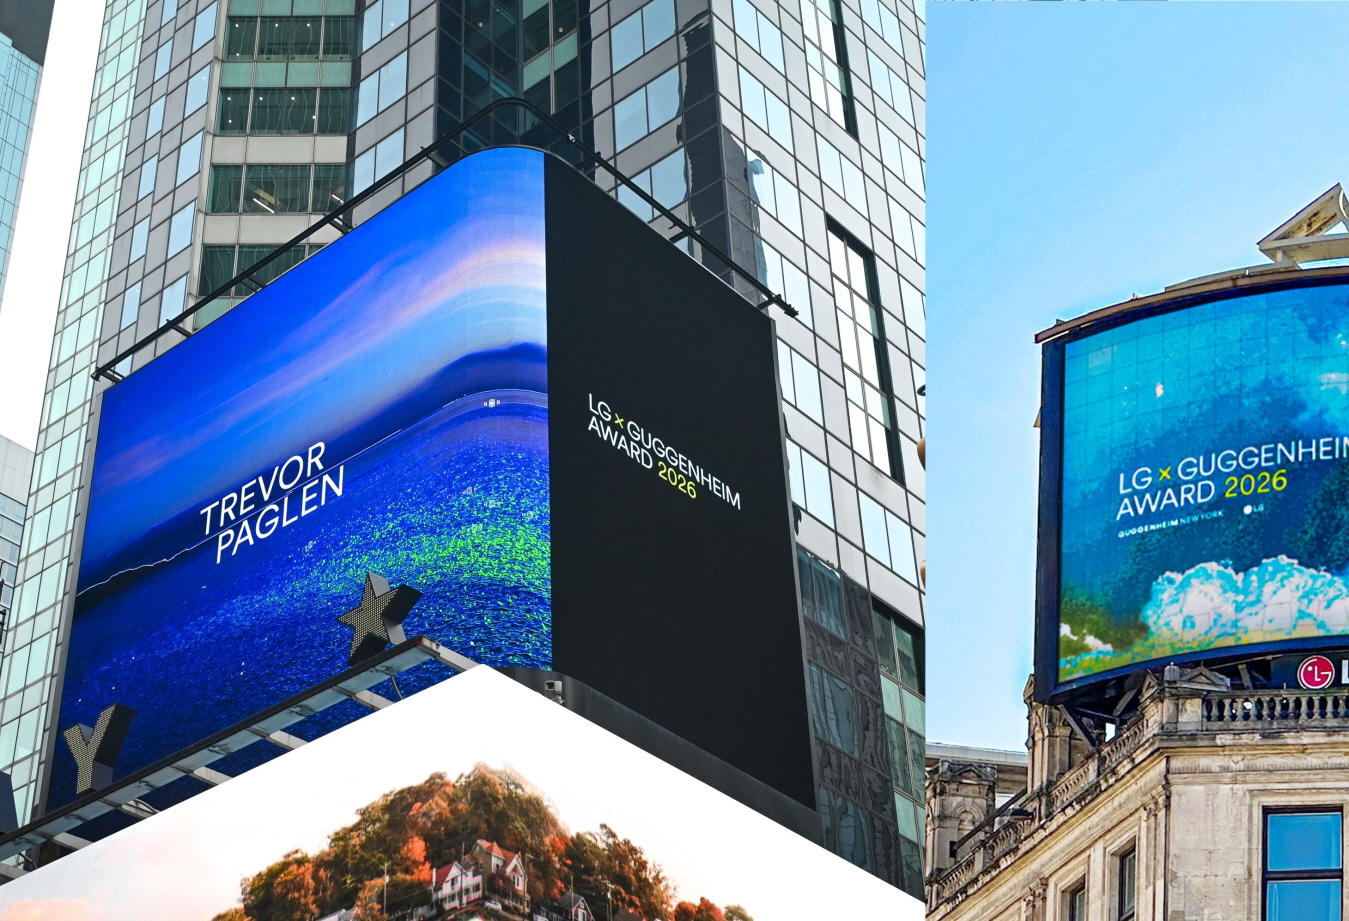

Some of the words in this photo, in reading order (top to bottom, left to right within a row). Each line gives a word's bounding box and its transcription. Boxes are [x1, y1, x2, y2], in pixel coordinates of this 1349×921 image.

[200, 441, 326, 536] TREVOR
[587, 416, 653, 469] AWARD
[658, 461, 697, 499] 2026
[588, 393, 611, 422] LG
[627, 420, 741, 511] GUGGENHEIM
[1116, 480, 1215, 521] AWARD
[1224, 469, 1288, 498] 2026
[1118, 466, 1153, 495] LG
[216, 464, 345, 565] PAGLEN
[1118, 519, 1178, 538] GUGGENHEIM
[1179, 514, 1199, 525] NEW
[1200, 510, 1224, 521] YORK
[62, 702, 118, 794] Y
